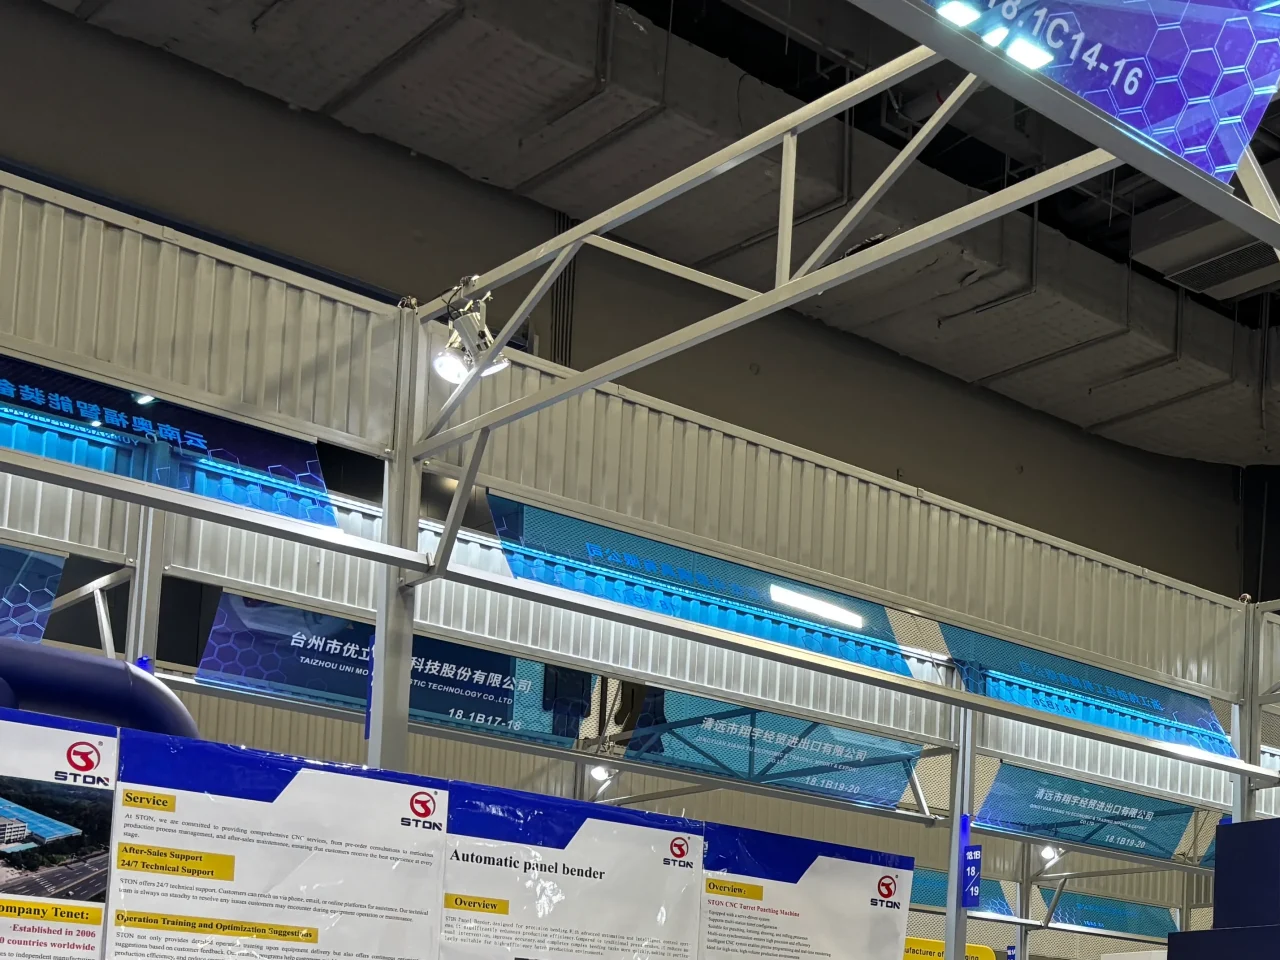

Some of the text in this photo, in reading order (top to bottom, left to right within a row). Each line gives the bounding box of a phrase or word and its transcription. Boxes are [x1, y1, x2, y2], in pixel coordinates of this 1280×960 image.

[300, 656, 338, 671] TAIZHOU
[339, 663, 354, 673] UNI
[427, 681, 481, 699] TECHNOLOGY
[448, 708, 522, 731] 18.1B17-18
[54, 770, 110, 787] STON
[805, 776, 860, 794] 18.1B19-20
[125, 792, 168, 808] Service
[400, 817, 443, 832] STON
[1105, 834, 1146, 849] 18.1B19-20
[121, 845, 203, 864] After-Sales Support
[120, 859, 214, 878] 24/7 Technical Support
[450, 849, 606, 880] Automatic panel bender
[663, 857, 694, 869] STON
[966, 866, 976, 877] 18
[169, 883, 195, 891] technical
[709, 882, 746, 895] Overview:
[970, 886, 979, 896] 19
[455, 897, 498, 910] Overview
[706, 899, 724, 907] STON
[724, 901, 738, 909] CNC
[870, 898, 901, 909] STON
[0, 905, 88, 919] ompany Tenet:
[116, 914, 158, 924] Operation
[161, 918, 196, 928] Training
[215, 923, 265, 933] Optimization
[7, 939, 94, 950] countries worldwide
[15, 951, 51, 960] independent
